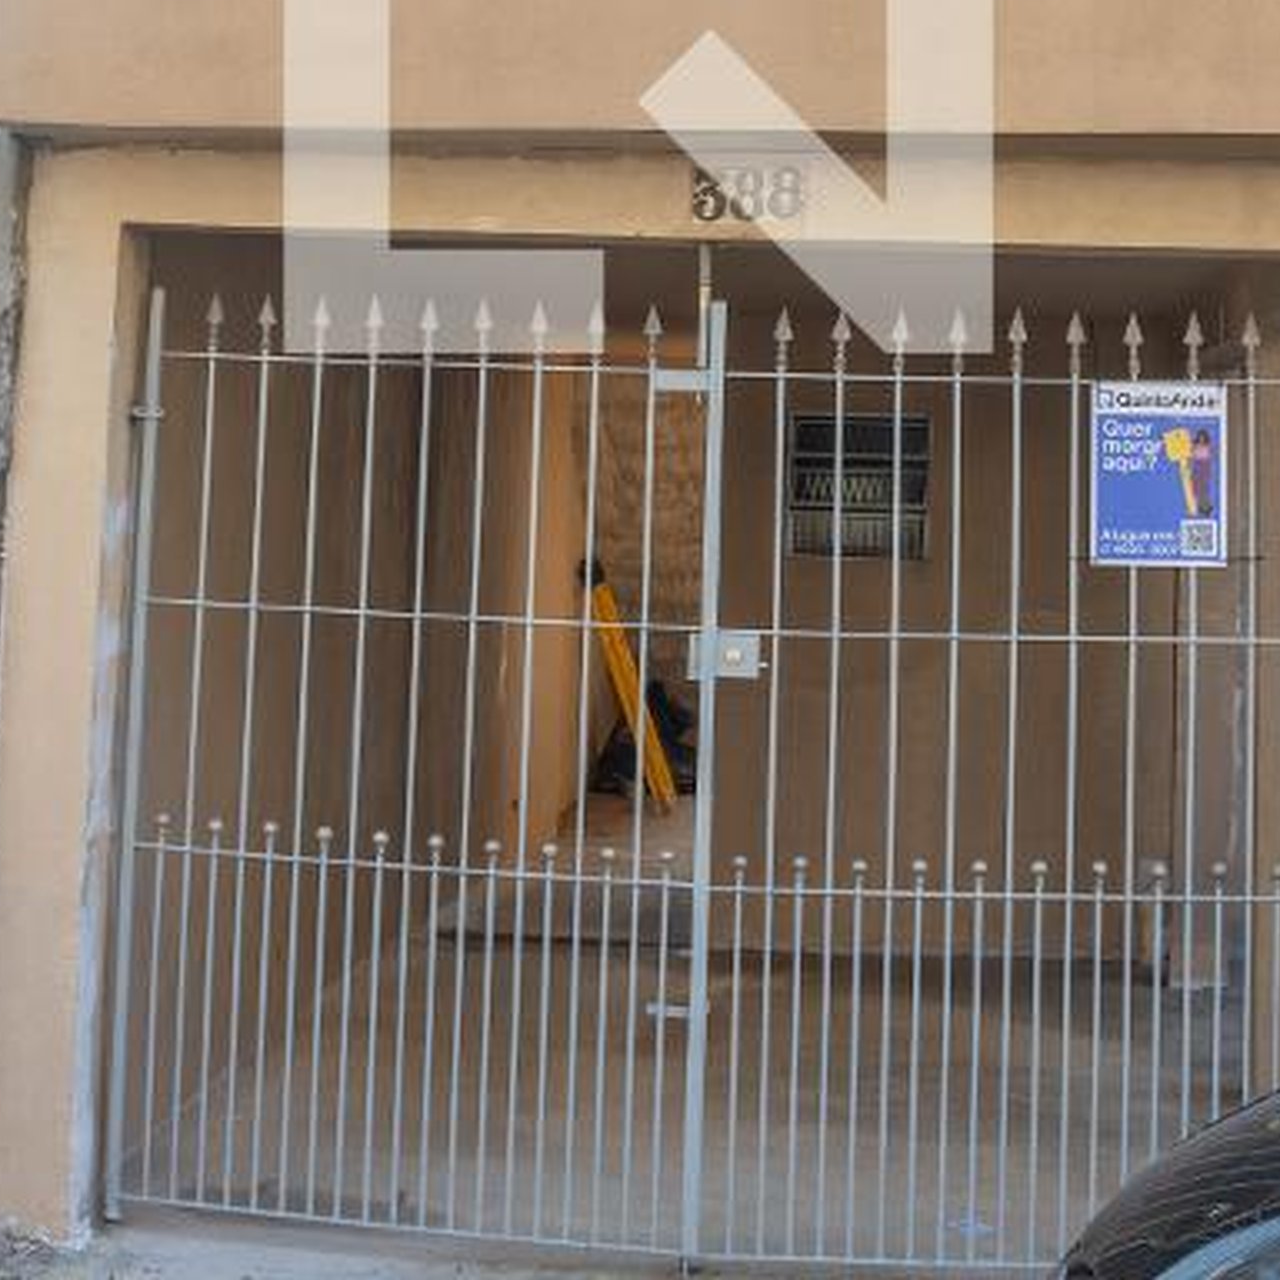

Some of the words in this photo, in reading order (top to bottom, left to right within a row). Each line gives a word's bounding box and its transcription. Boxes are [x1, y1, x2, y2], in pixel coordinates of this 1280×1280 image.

[1102, 420, 1153, 437] Quer
[1102, 439, 1161, 454] morar
[1102, 455, 1158, 472] aqui?
